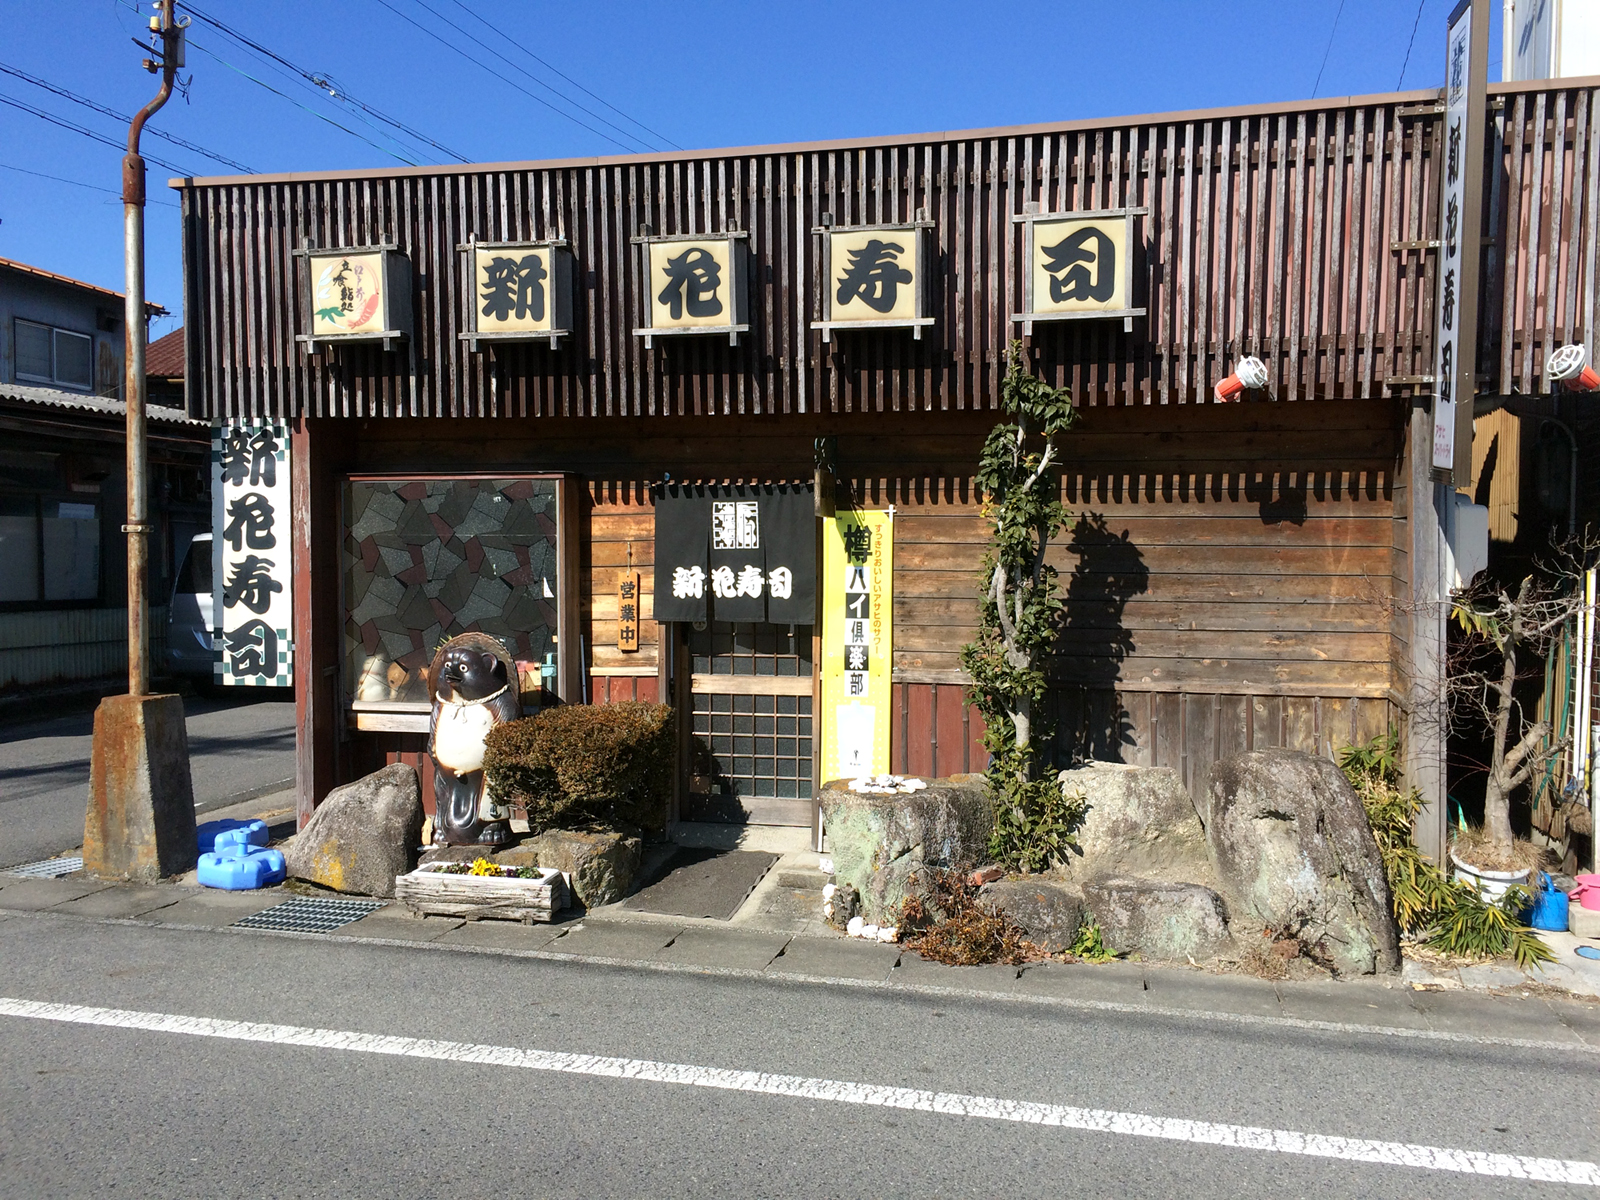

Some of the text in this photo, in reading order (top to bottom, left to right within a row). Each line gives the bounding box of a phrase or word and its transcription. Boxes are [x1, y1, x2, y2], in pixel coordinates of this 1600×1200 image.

[481, 254, 547, 322] 新
[658, 247, 723, 320] 花
[837, 239, 912, 314] 寿
[1041, 226, 1116, 303] 司
[1441, 116, 1460, 404] 新花寿司
[220, 429, 283, 679] 新花寿司
[672, 565, 793, 600] 新花寿司
[873, 524, 883, 654] すっきりおいしいアサヒのサワー
[620, 581, 636, 644] 営業中
[844, 524, 873, 695] 樽ハイ倶楽部
